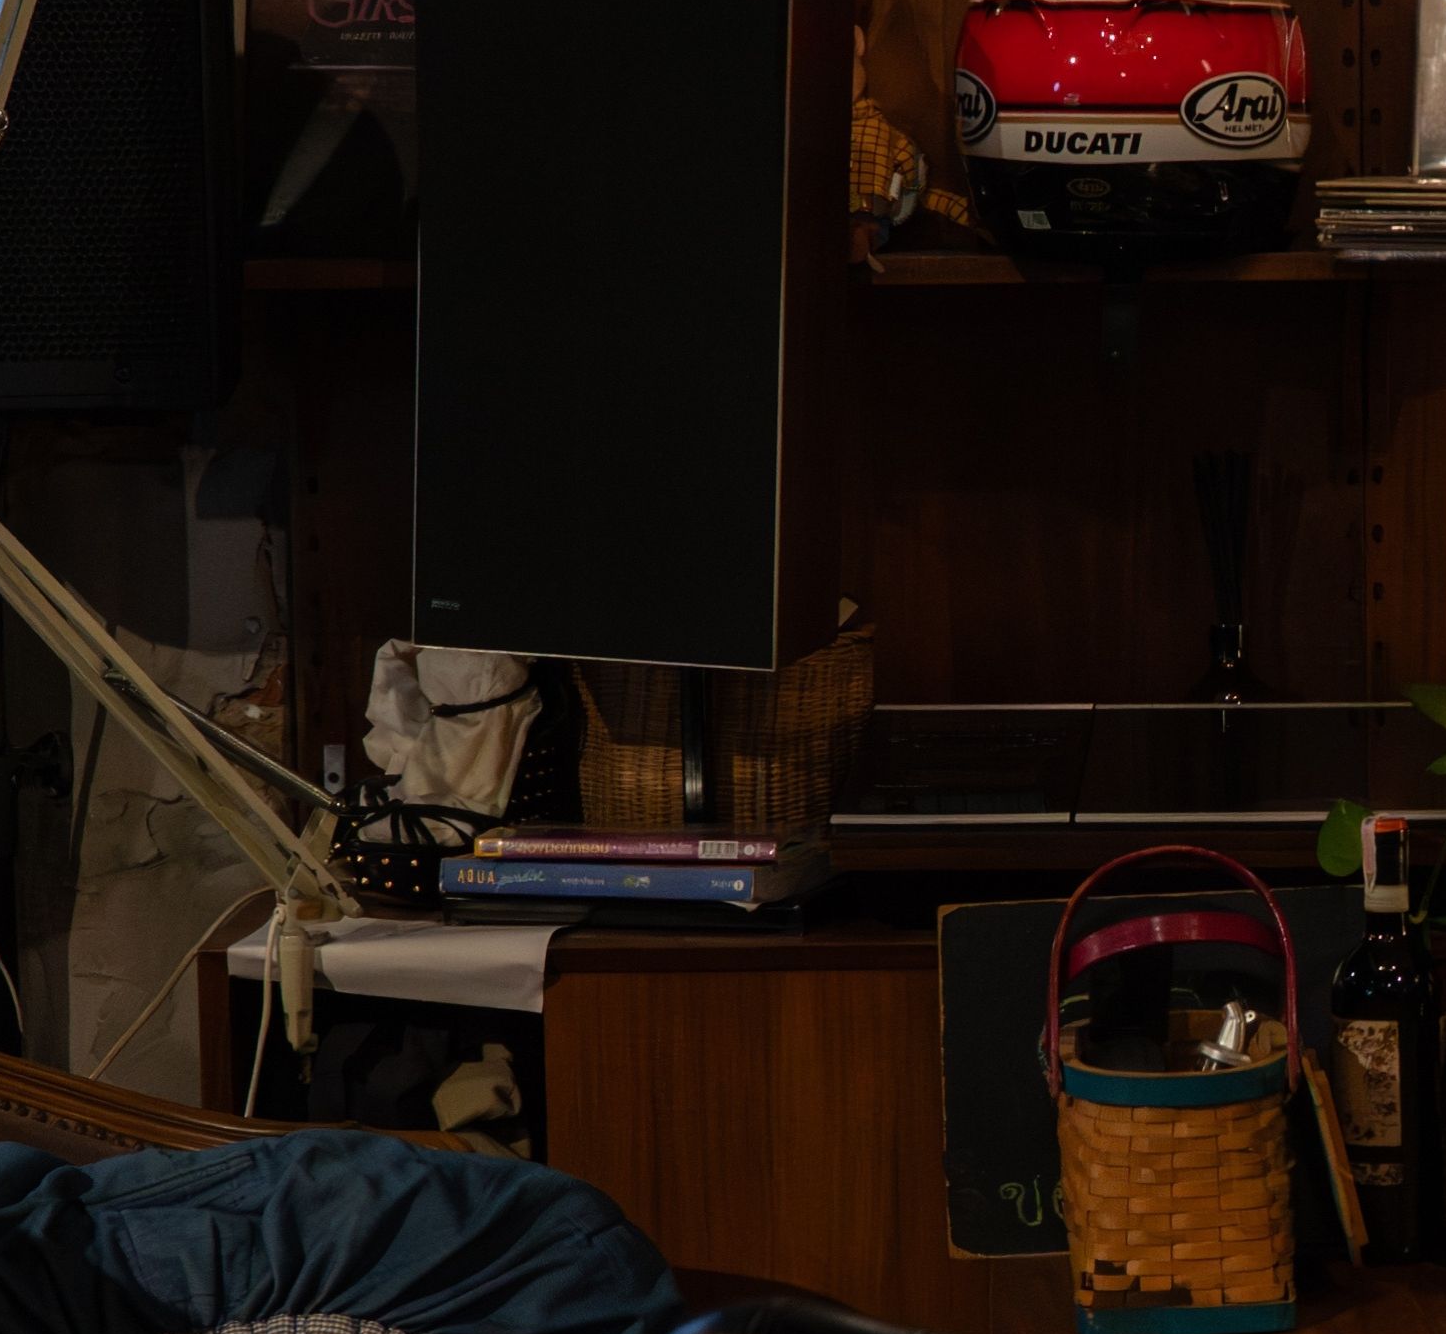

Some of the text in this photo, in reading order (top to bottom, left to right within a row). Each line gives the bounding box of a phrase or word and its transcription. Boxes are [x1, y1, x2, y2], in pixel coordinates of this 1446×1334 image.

[1193, 82, 1280, 125] Arai
[1023, 131, 1142, 155] DUCATI
[457, 868, 496, 884] AQUA
